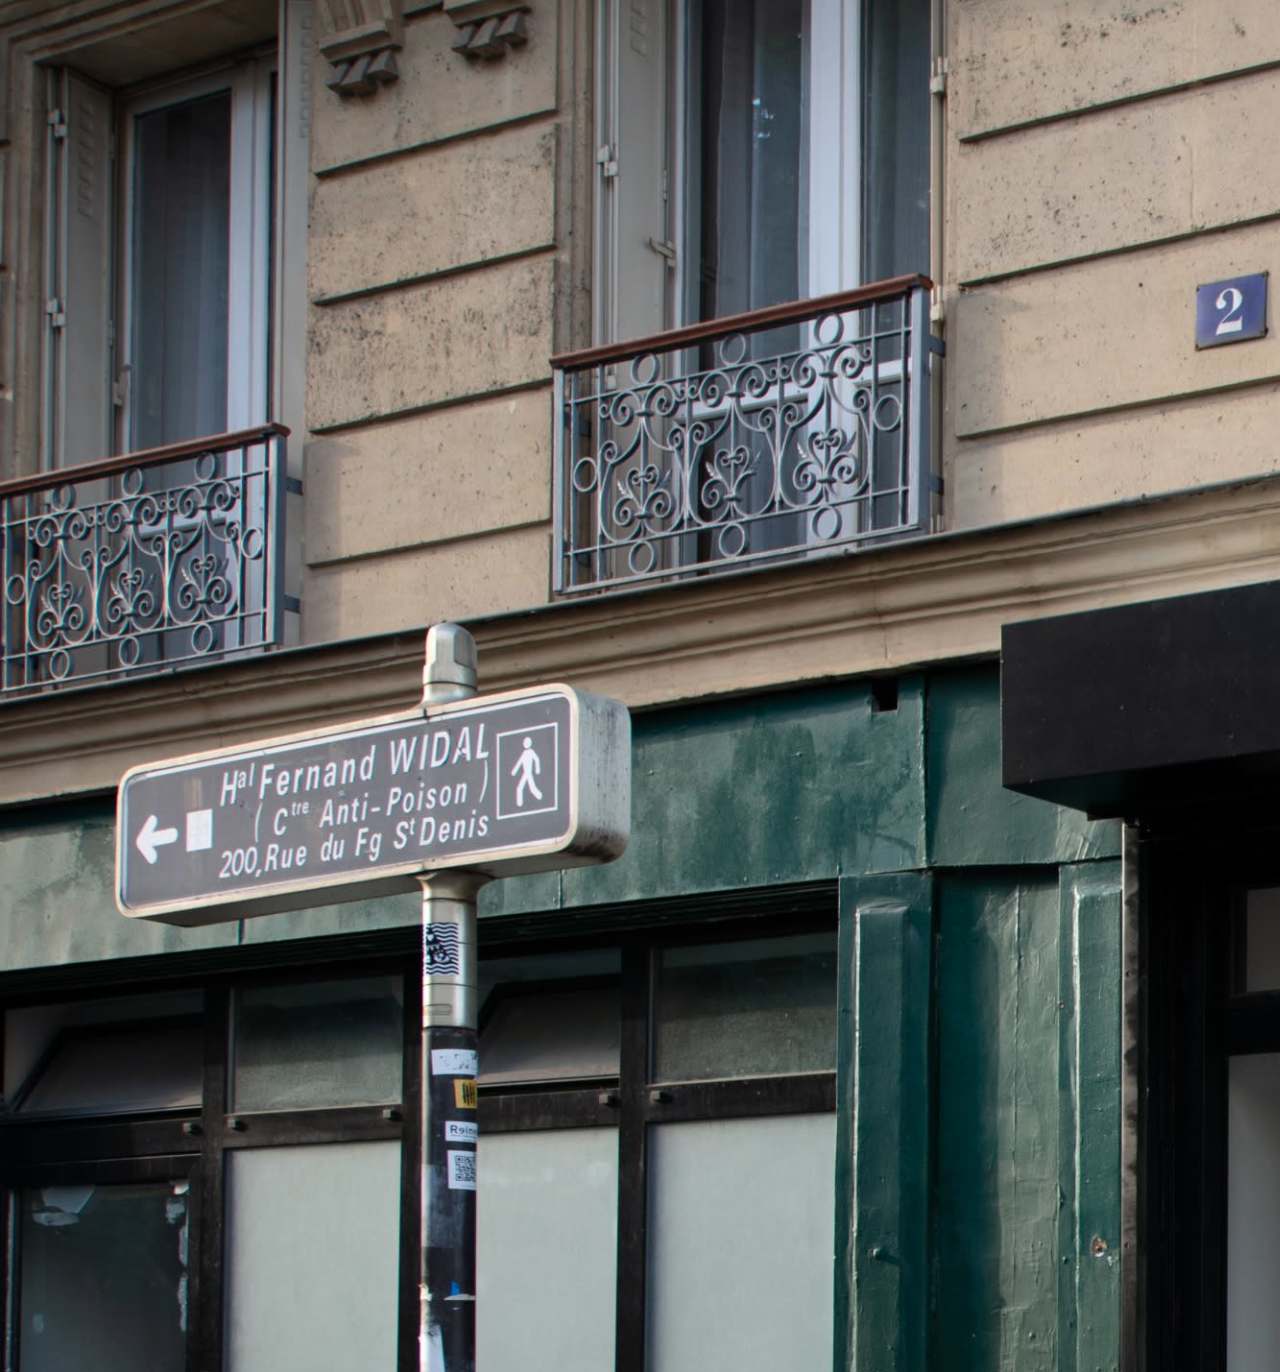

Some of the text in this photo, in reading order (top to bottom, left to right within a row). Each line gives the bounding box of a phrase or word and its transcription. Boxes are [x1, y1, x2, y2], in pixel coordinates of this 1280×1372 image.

[1215, 287, 1243, 336] 2
[219, 723, 489, 807] Hal Fernand WIDAL
[320, 832, 345, 862] du
[355, 827, 382, 862] Fg
[419, 809, 490, 847] Denis
